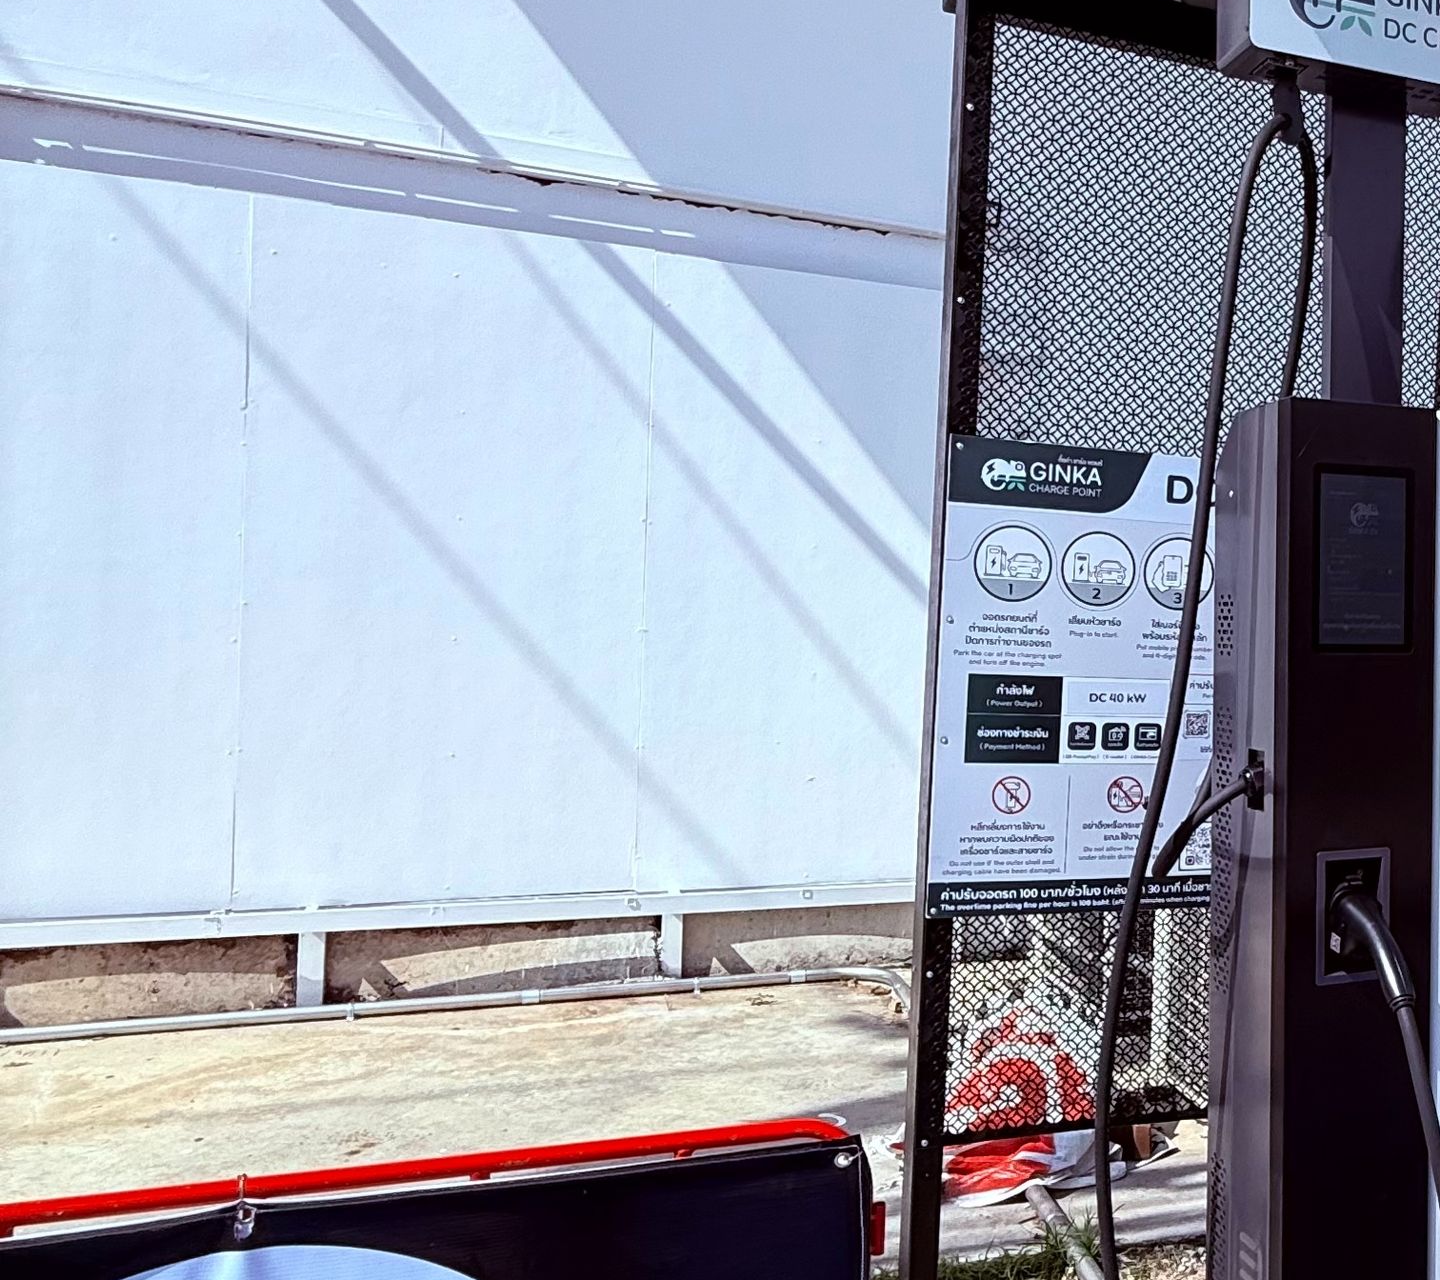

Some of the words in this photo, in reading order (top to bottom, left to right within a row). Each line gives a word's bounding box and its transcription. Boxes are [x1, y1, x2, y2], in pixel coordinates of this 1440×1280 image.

[1384, 18, 1417, 44] DC
[1029, 461, 1102, 487] GINKA
[1028, 483, 1070, 496] CHARGE
[1072, 487, 1103, 497] POINT
[1166, 474, 1194, 505] D
[1008, 583, 1014, 595] 1
[1092, 588, 1101, 600] 2
[1173, 592, 1182, 604] 3
[995, 681, 1035, 696] กำลังไฟ
[1089, 692, 1107, 703] DC
[1110, 692, 1124, 703] 40
[1127, 692, 1147, 703] kW
[940, 887, 1017, 901] ค่าปรับจอดรถ
[1020, 888, 1038, 899] 100
[1041, 881, 1102, 898] บาท/ชั่วโมง
[1147, 884, 1160, 894] 30
[1162, 881, 1181, 893] นาที
